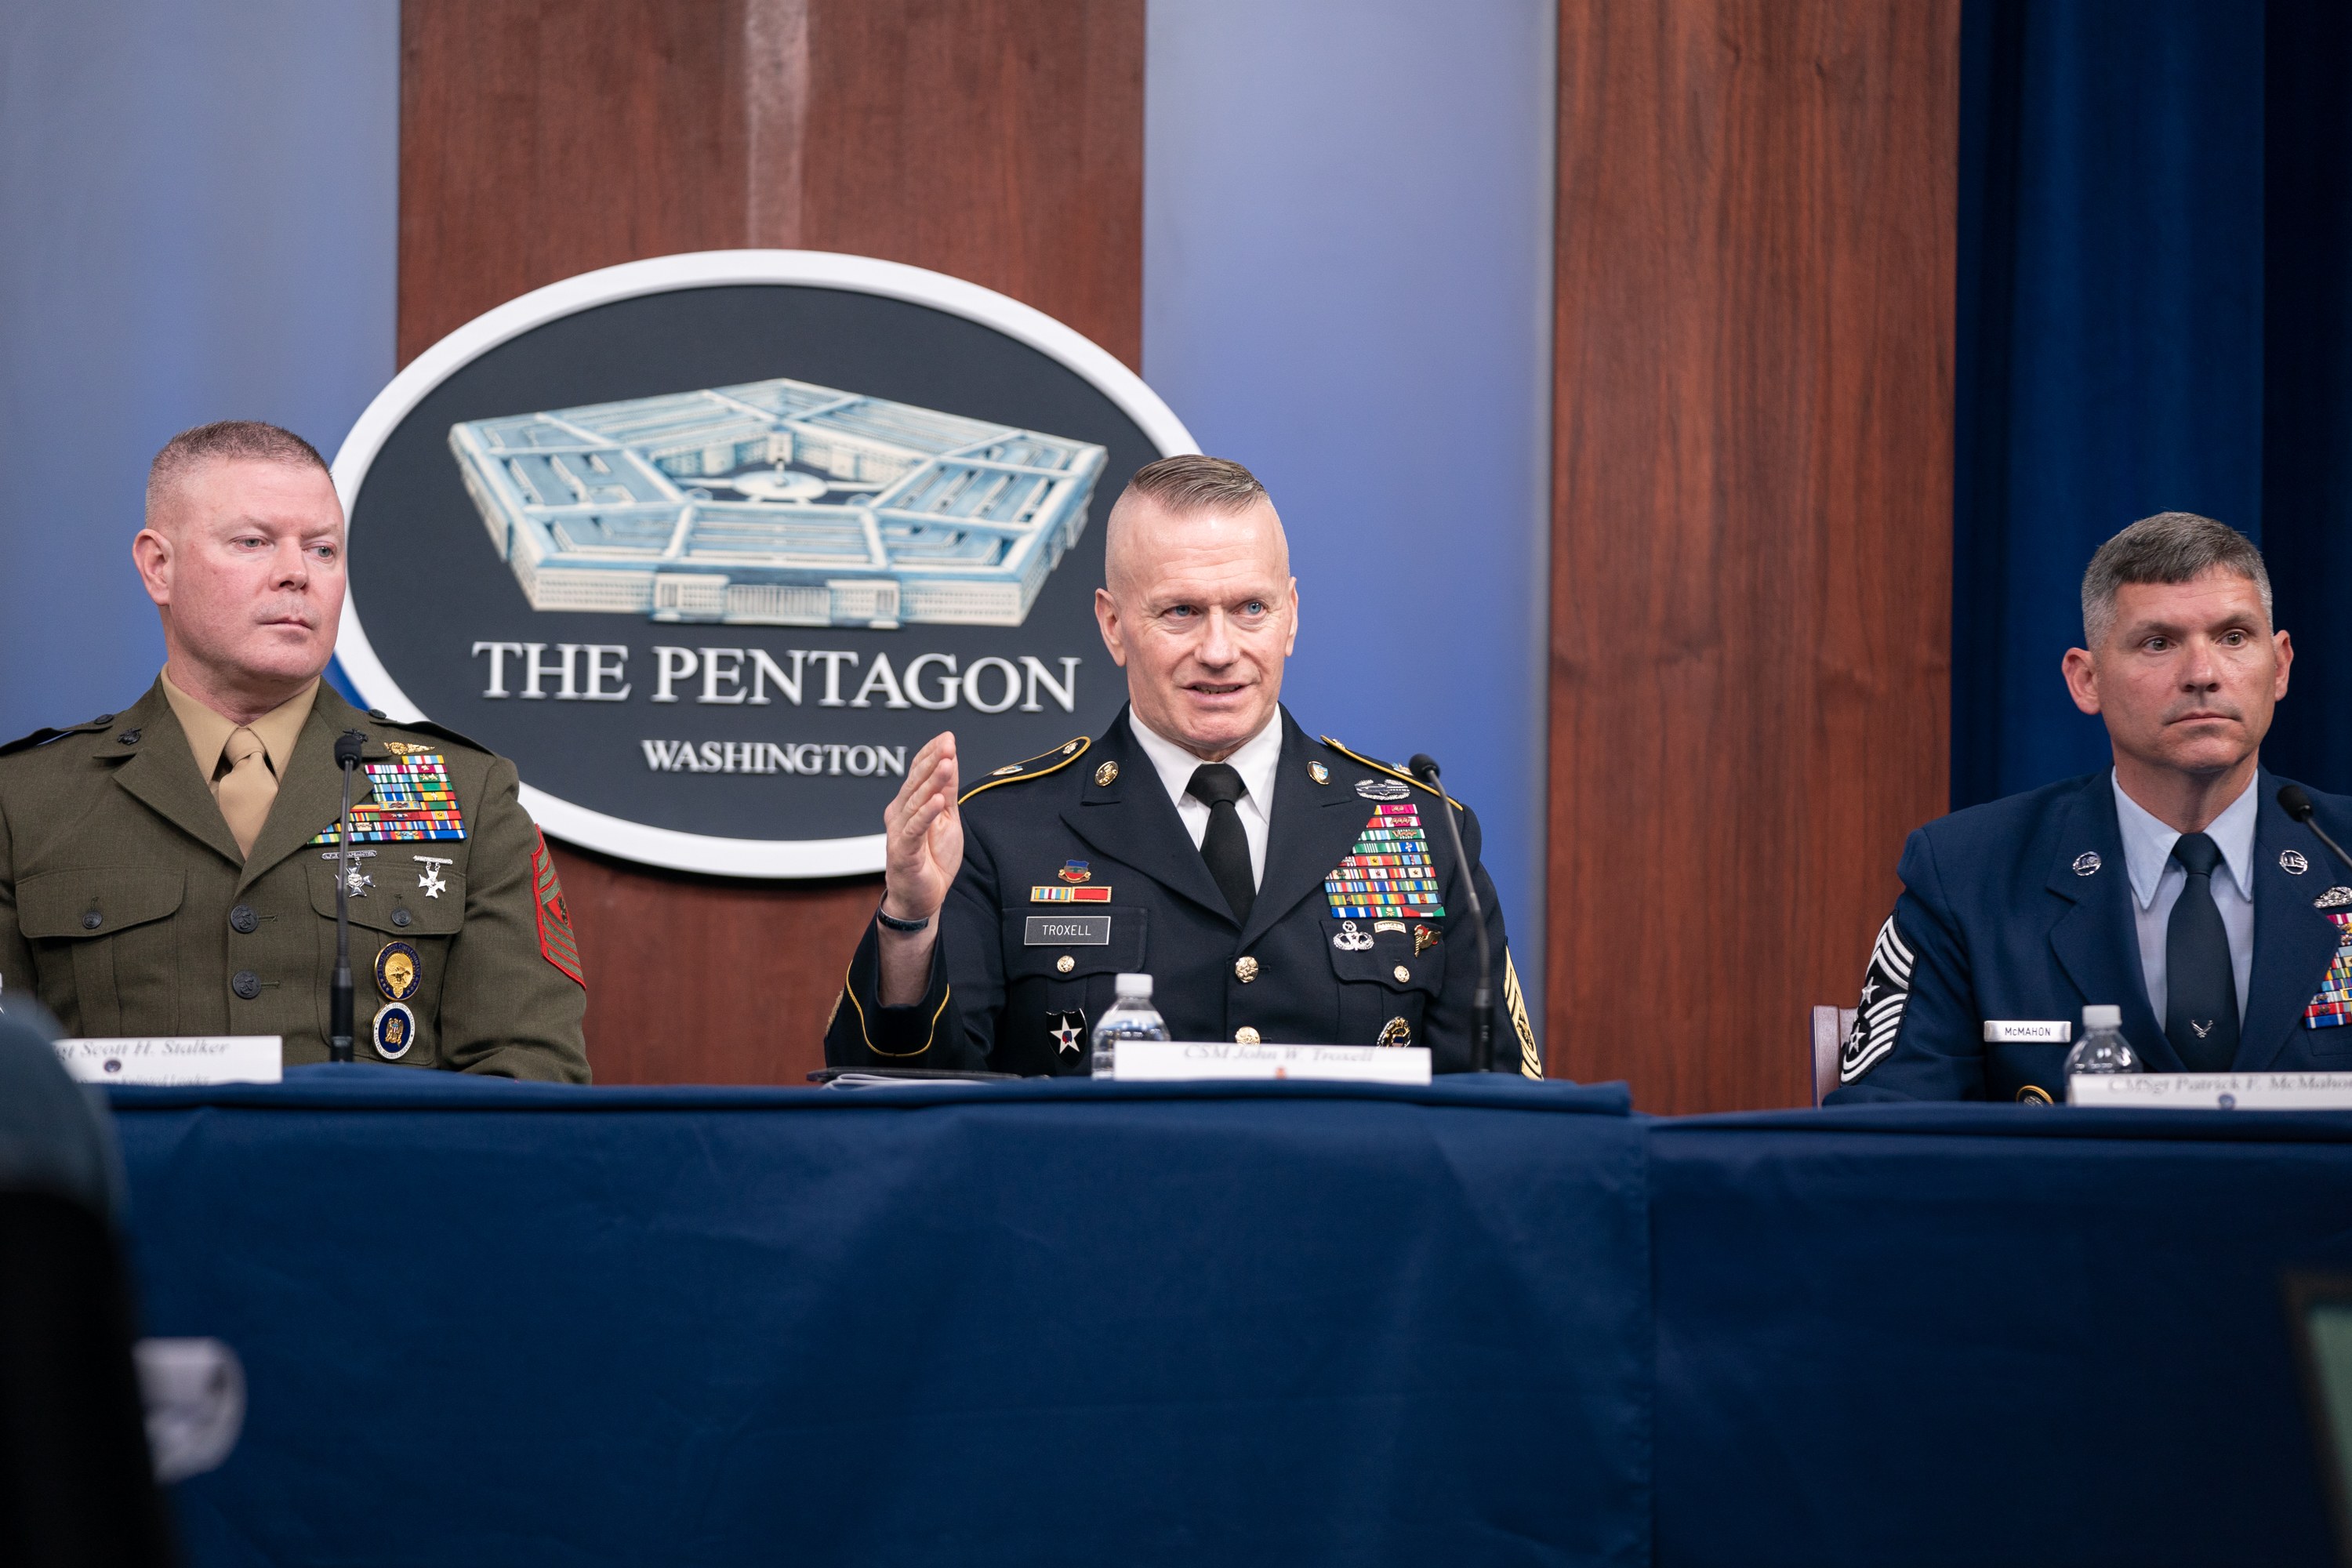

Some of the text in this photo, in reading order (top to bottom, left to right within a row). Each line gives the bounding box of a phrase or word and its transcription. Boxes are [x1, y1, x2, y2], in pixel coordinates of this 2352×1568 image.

[472, 641, 1082, 713] THE PENTAGON
[641, 741, 907, 776] WASHINGTON
[1042, 924, 1091, 936] TROXELL
[2005, 1027, 2051, 1036] McMAHON
[80, 1040, 128, 1057] Scott
[132, 1040, 154, 1056] H.
[162, 1039, 230, 1056] Stalker
[1184, 1044, 1229, 1059] CSM
[1233, 1046, 1277, 1061] John
[1312, 1047, 1375, 1062] Troxell
[2108, 1076, 2169, 1095] CMSgt
[2175, 1076, 2239, 1092] Patrick
